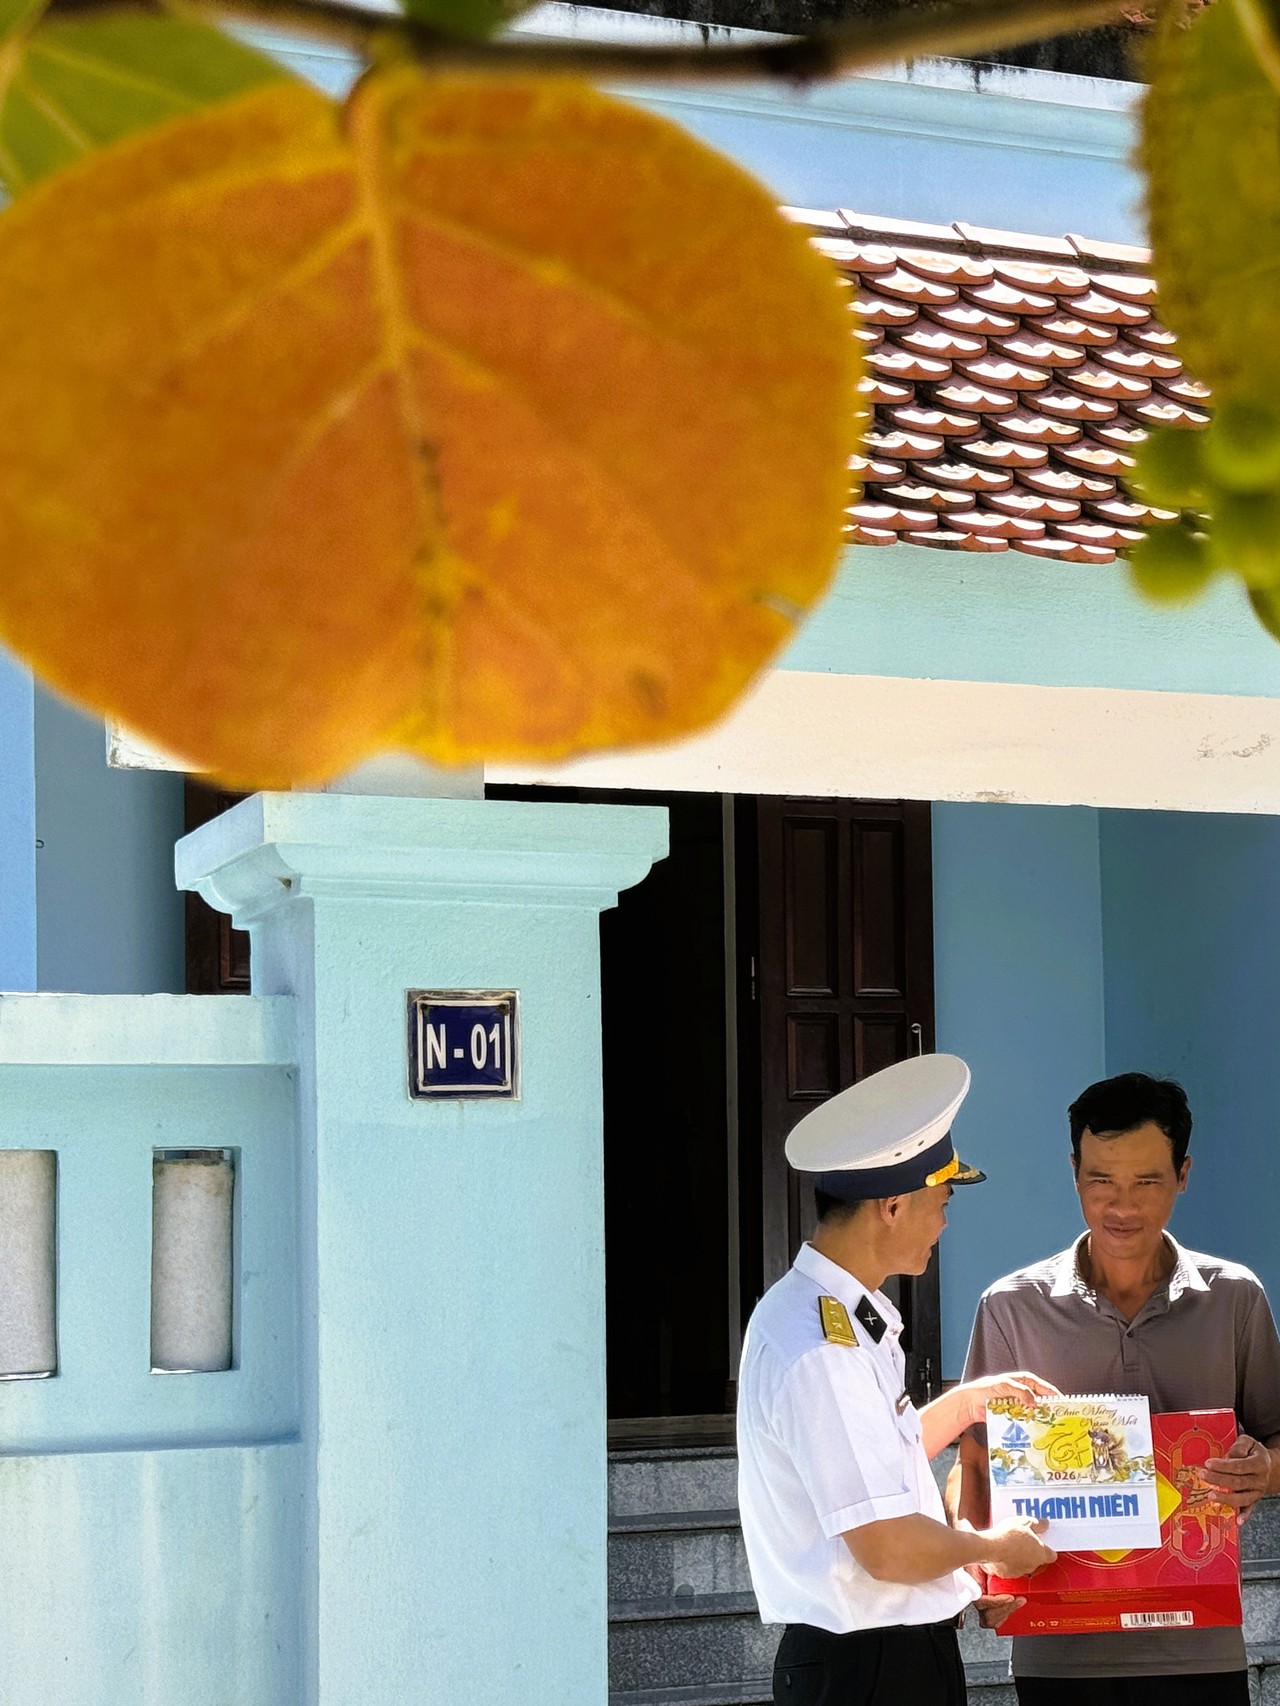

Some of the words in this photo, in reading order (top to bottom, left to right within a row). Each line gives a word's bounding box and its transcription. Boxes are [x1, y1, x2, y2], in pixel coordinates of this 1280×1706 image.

[1046, 1471, 1076, 1481] 2026
[1012, 1496, 1087, 1520] THANH
[1088, 1493, 1140, 1518] NIÊN
